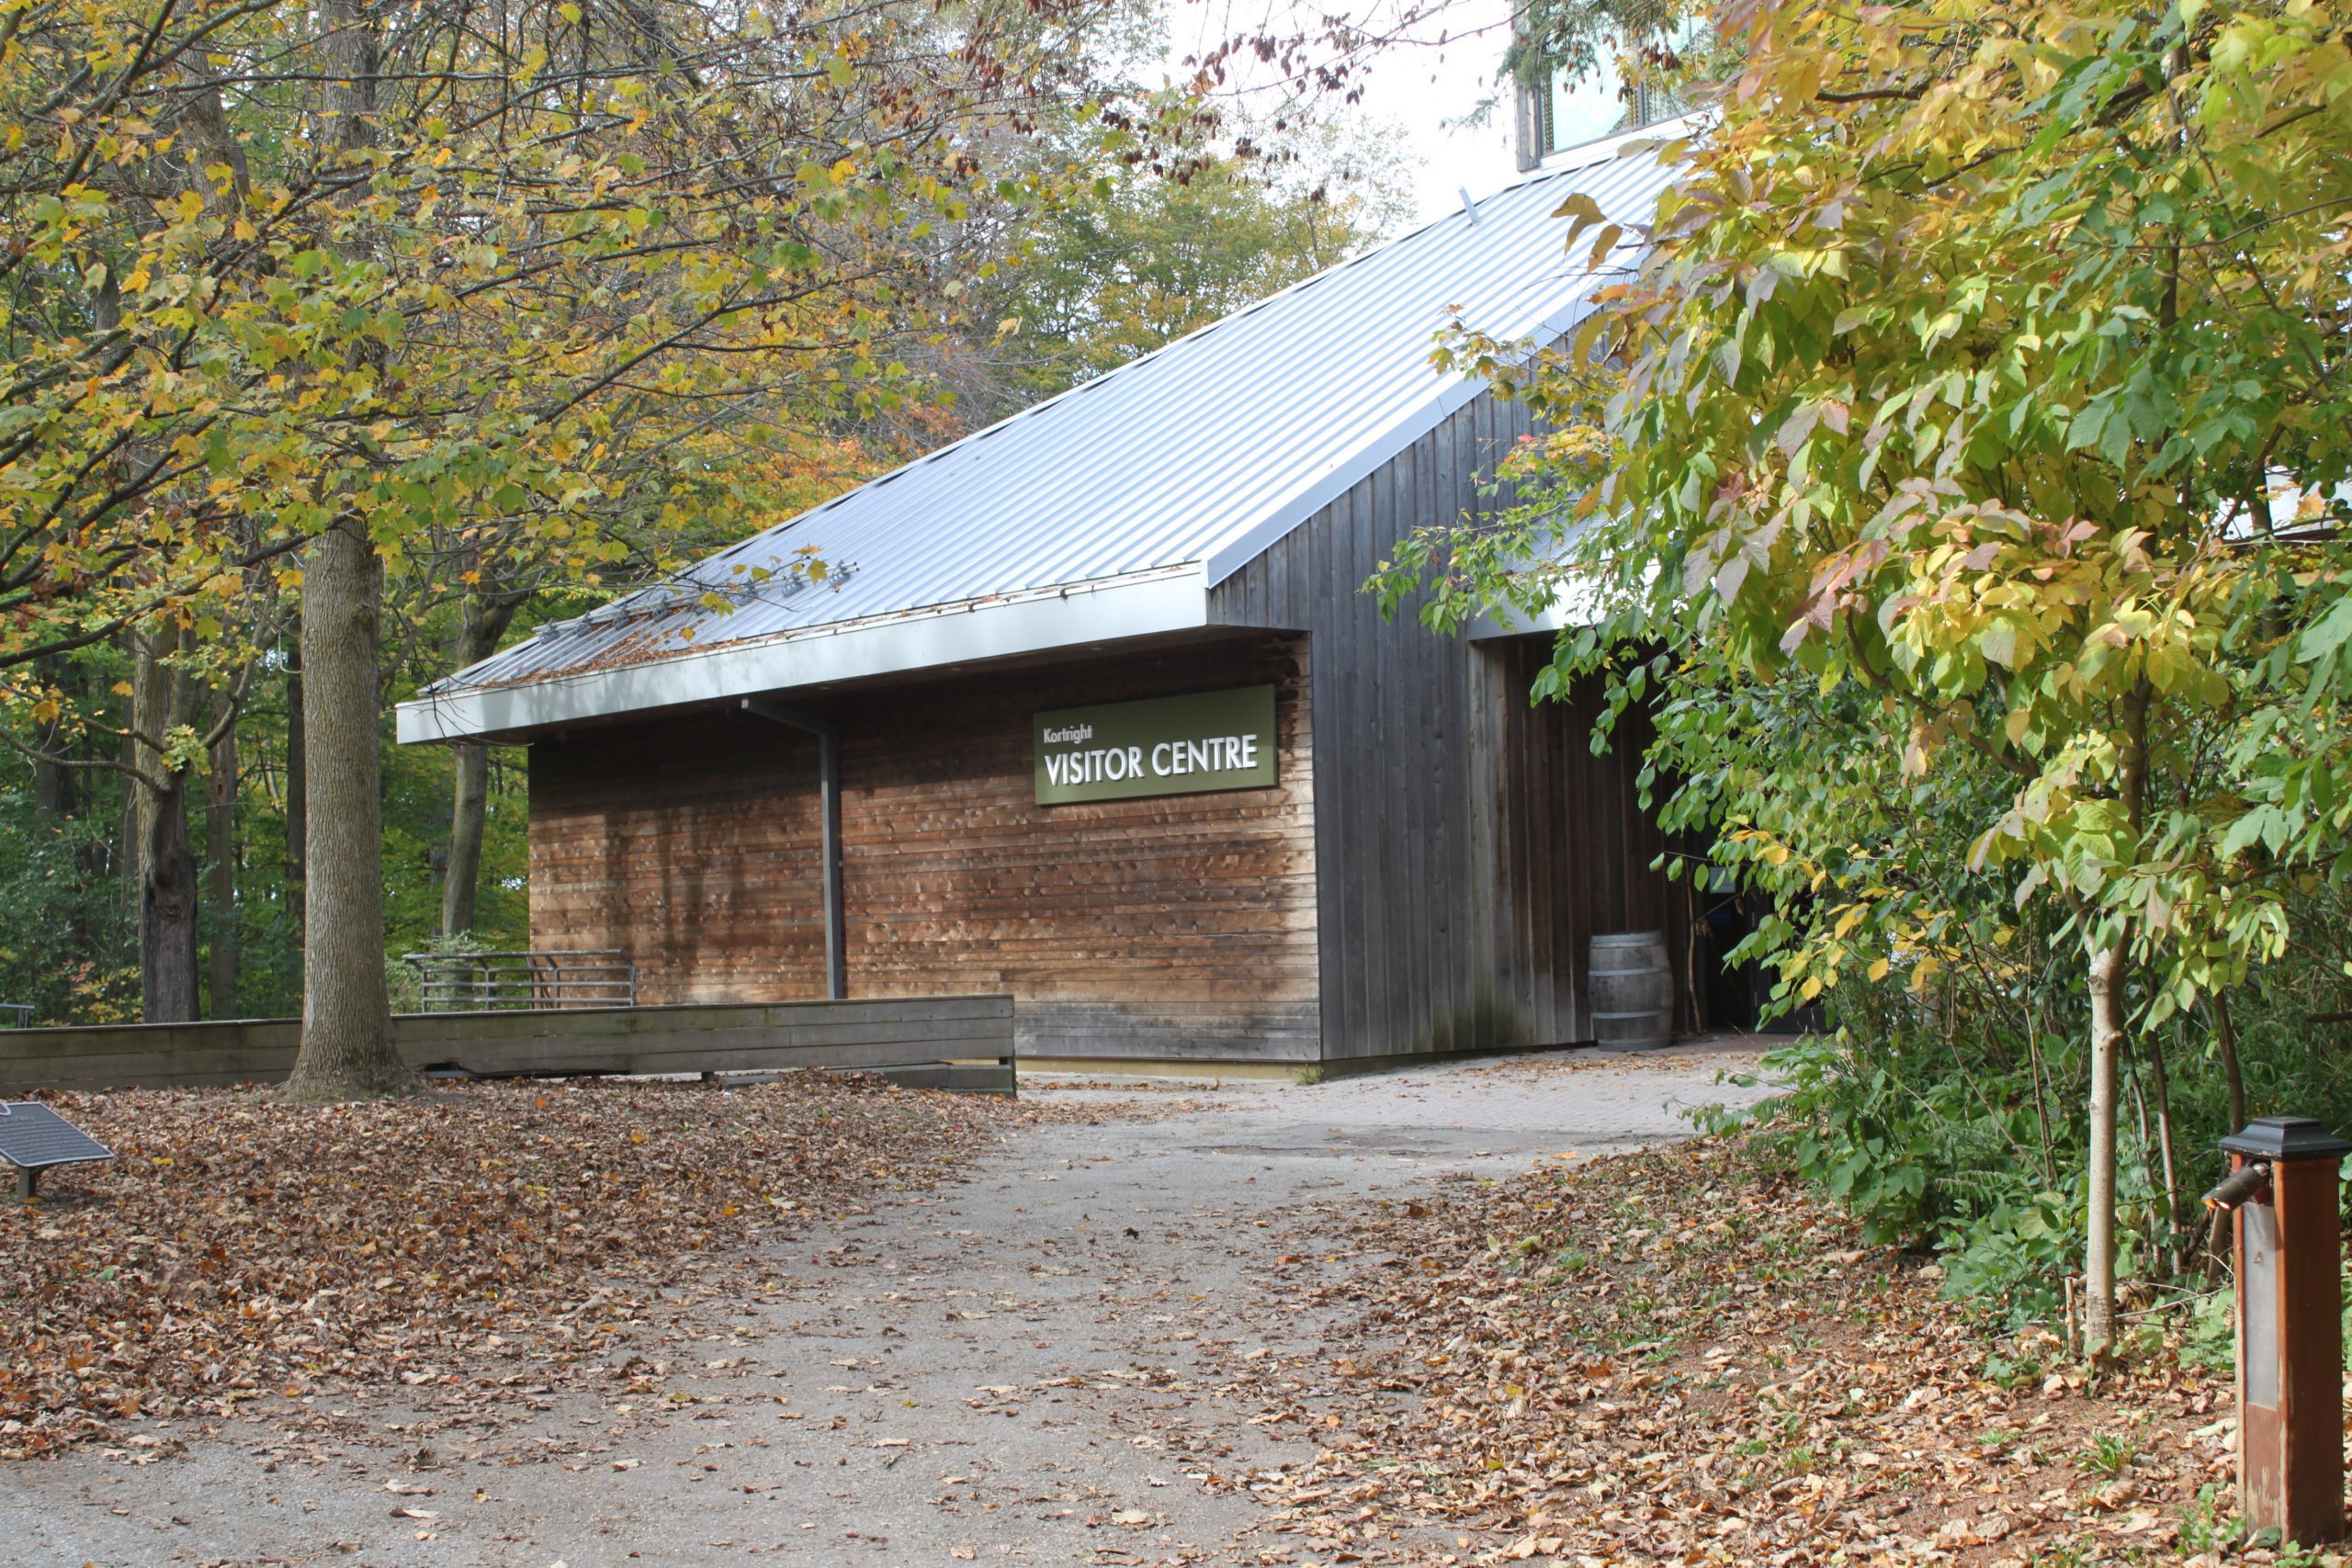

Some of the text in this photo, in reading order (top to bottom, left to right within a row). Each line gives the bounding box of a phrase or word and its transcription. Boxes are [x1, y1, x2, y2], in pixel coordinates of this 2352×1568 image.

[1044, 723, 1092, 744] Kortright
[1045, 734, 1258, 785] VISITOR CENTRE
